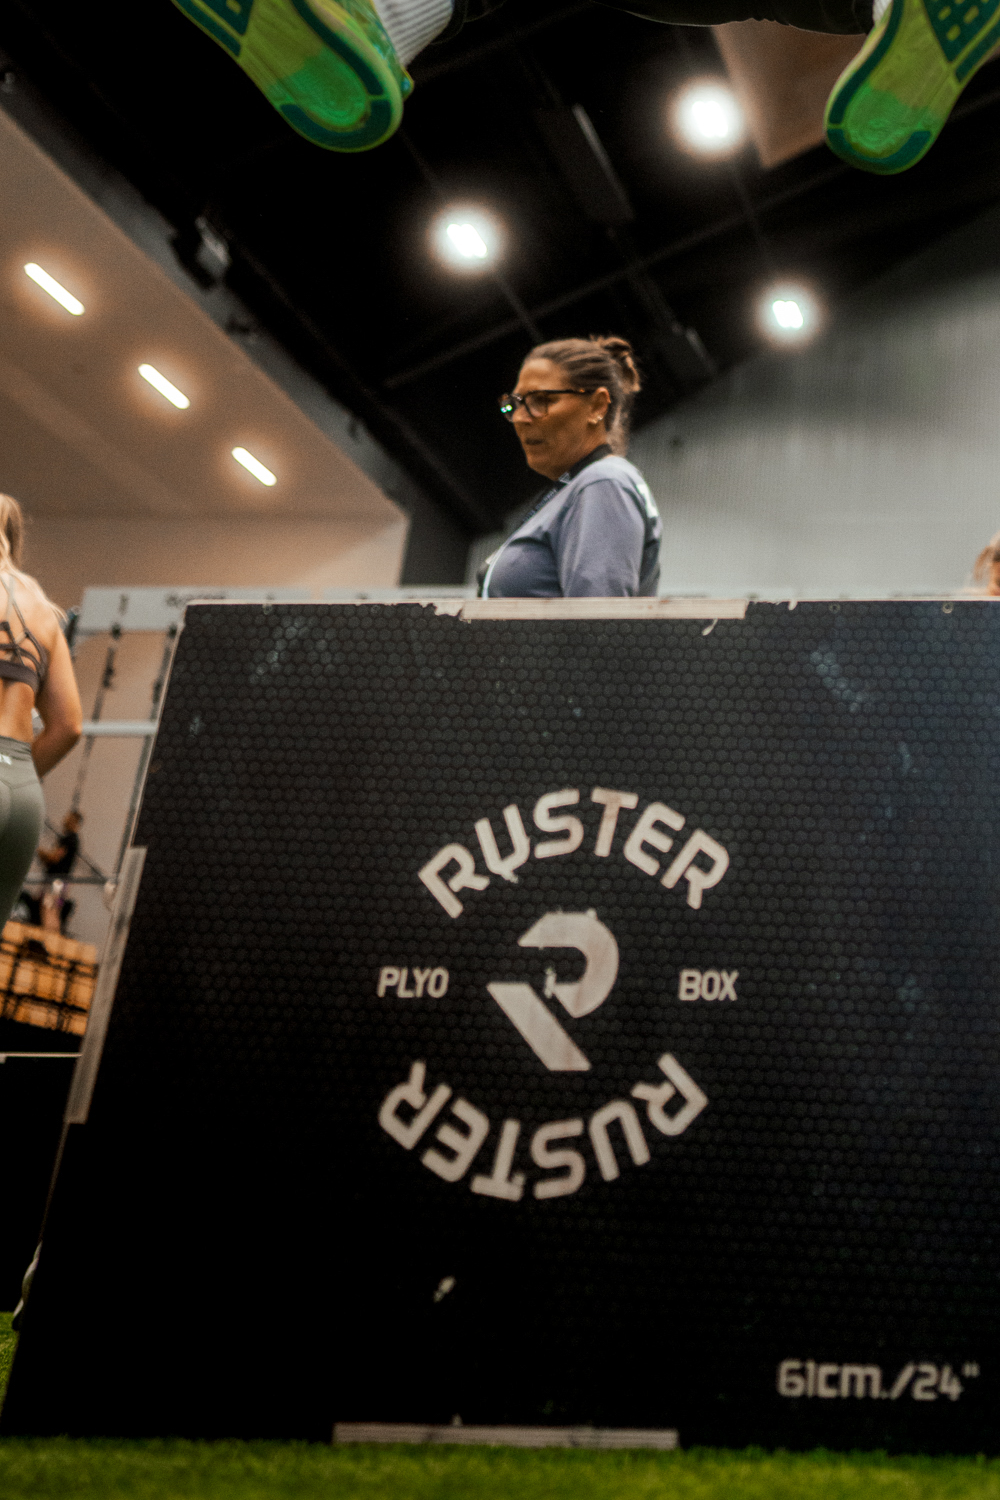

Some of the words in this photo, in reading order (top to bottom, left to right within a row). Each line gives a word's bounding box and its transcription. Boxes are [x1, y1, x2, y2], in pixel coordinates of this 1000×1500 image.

[418, 787, 730, 919] RUSTER
[377, 966, 450, 999] PLYO
[677, 969, 739, 1001] BOX
[378, 1052, 709, 1202] RUSTER
